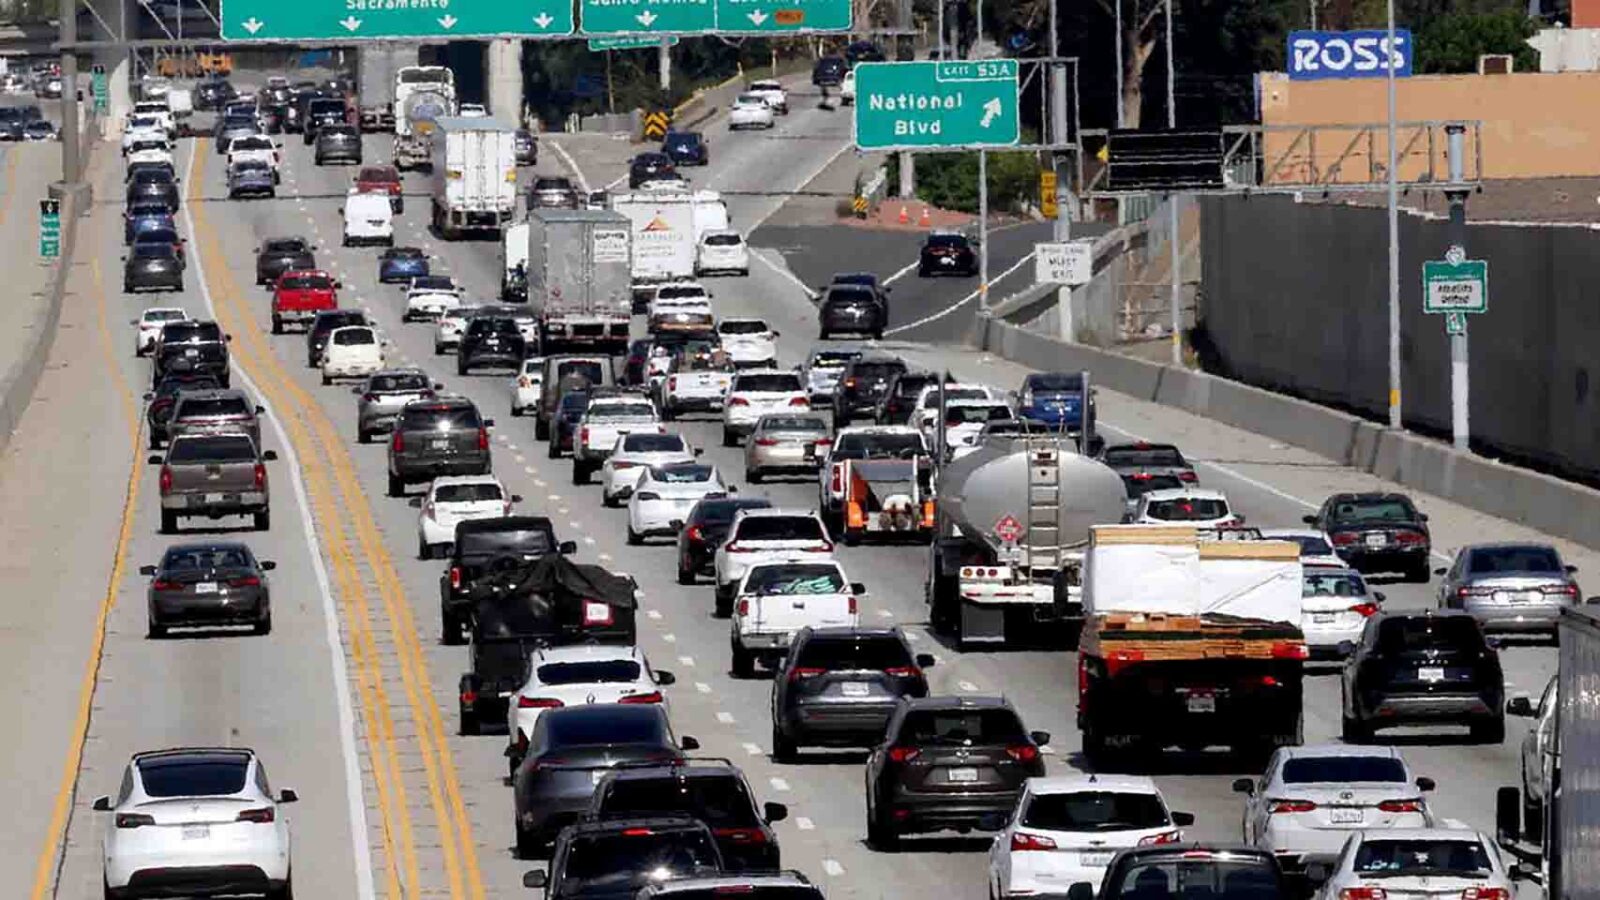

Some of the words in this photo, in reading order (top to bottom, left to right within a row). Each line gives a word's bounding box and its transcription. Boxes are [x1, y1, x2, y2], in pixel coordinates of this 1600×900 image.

[346, 0, 449, 10] Sacramento
[1293, 37, 1405, 71] ROSS
[869, 92, 962, 110] National
[894, 120, 941, 135] Blvd
